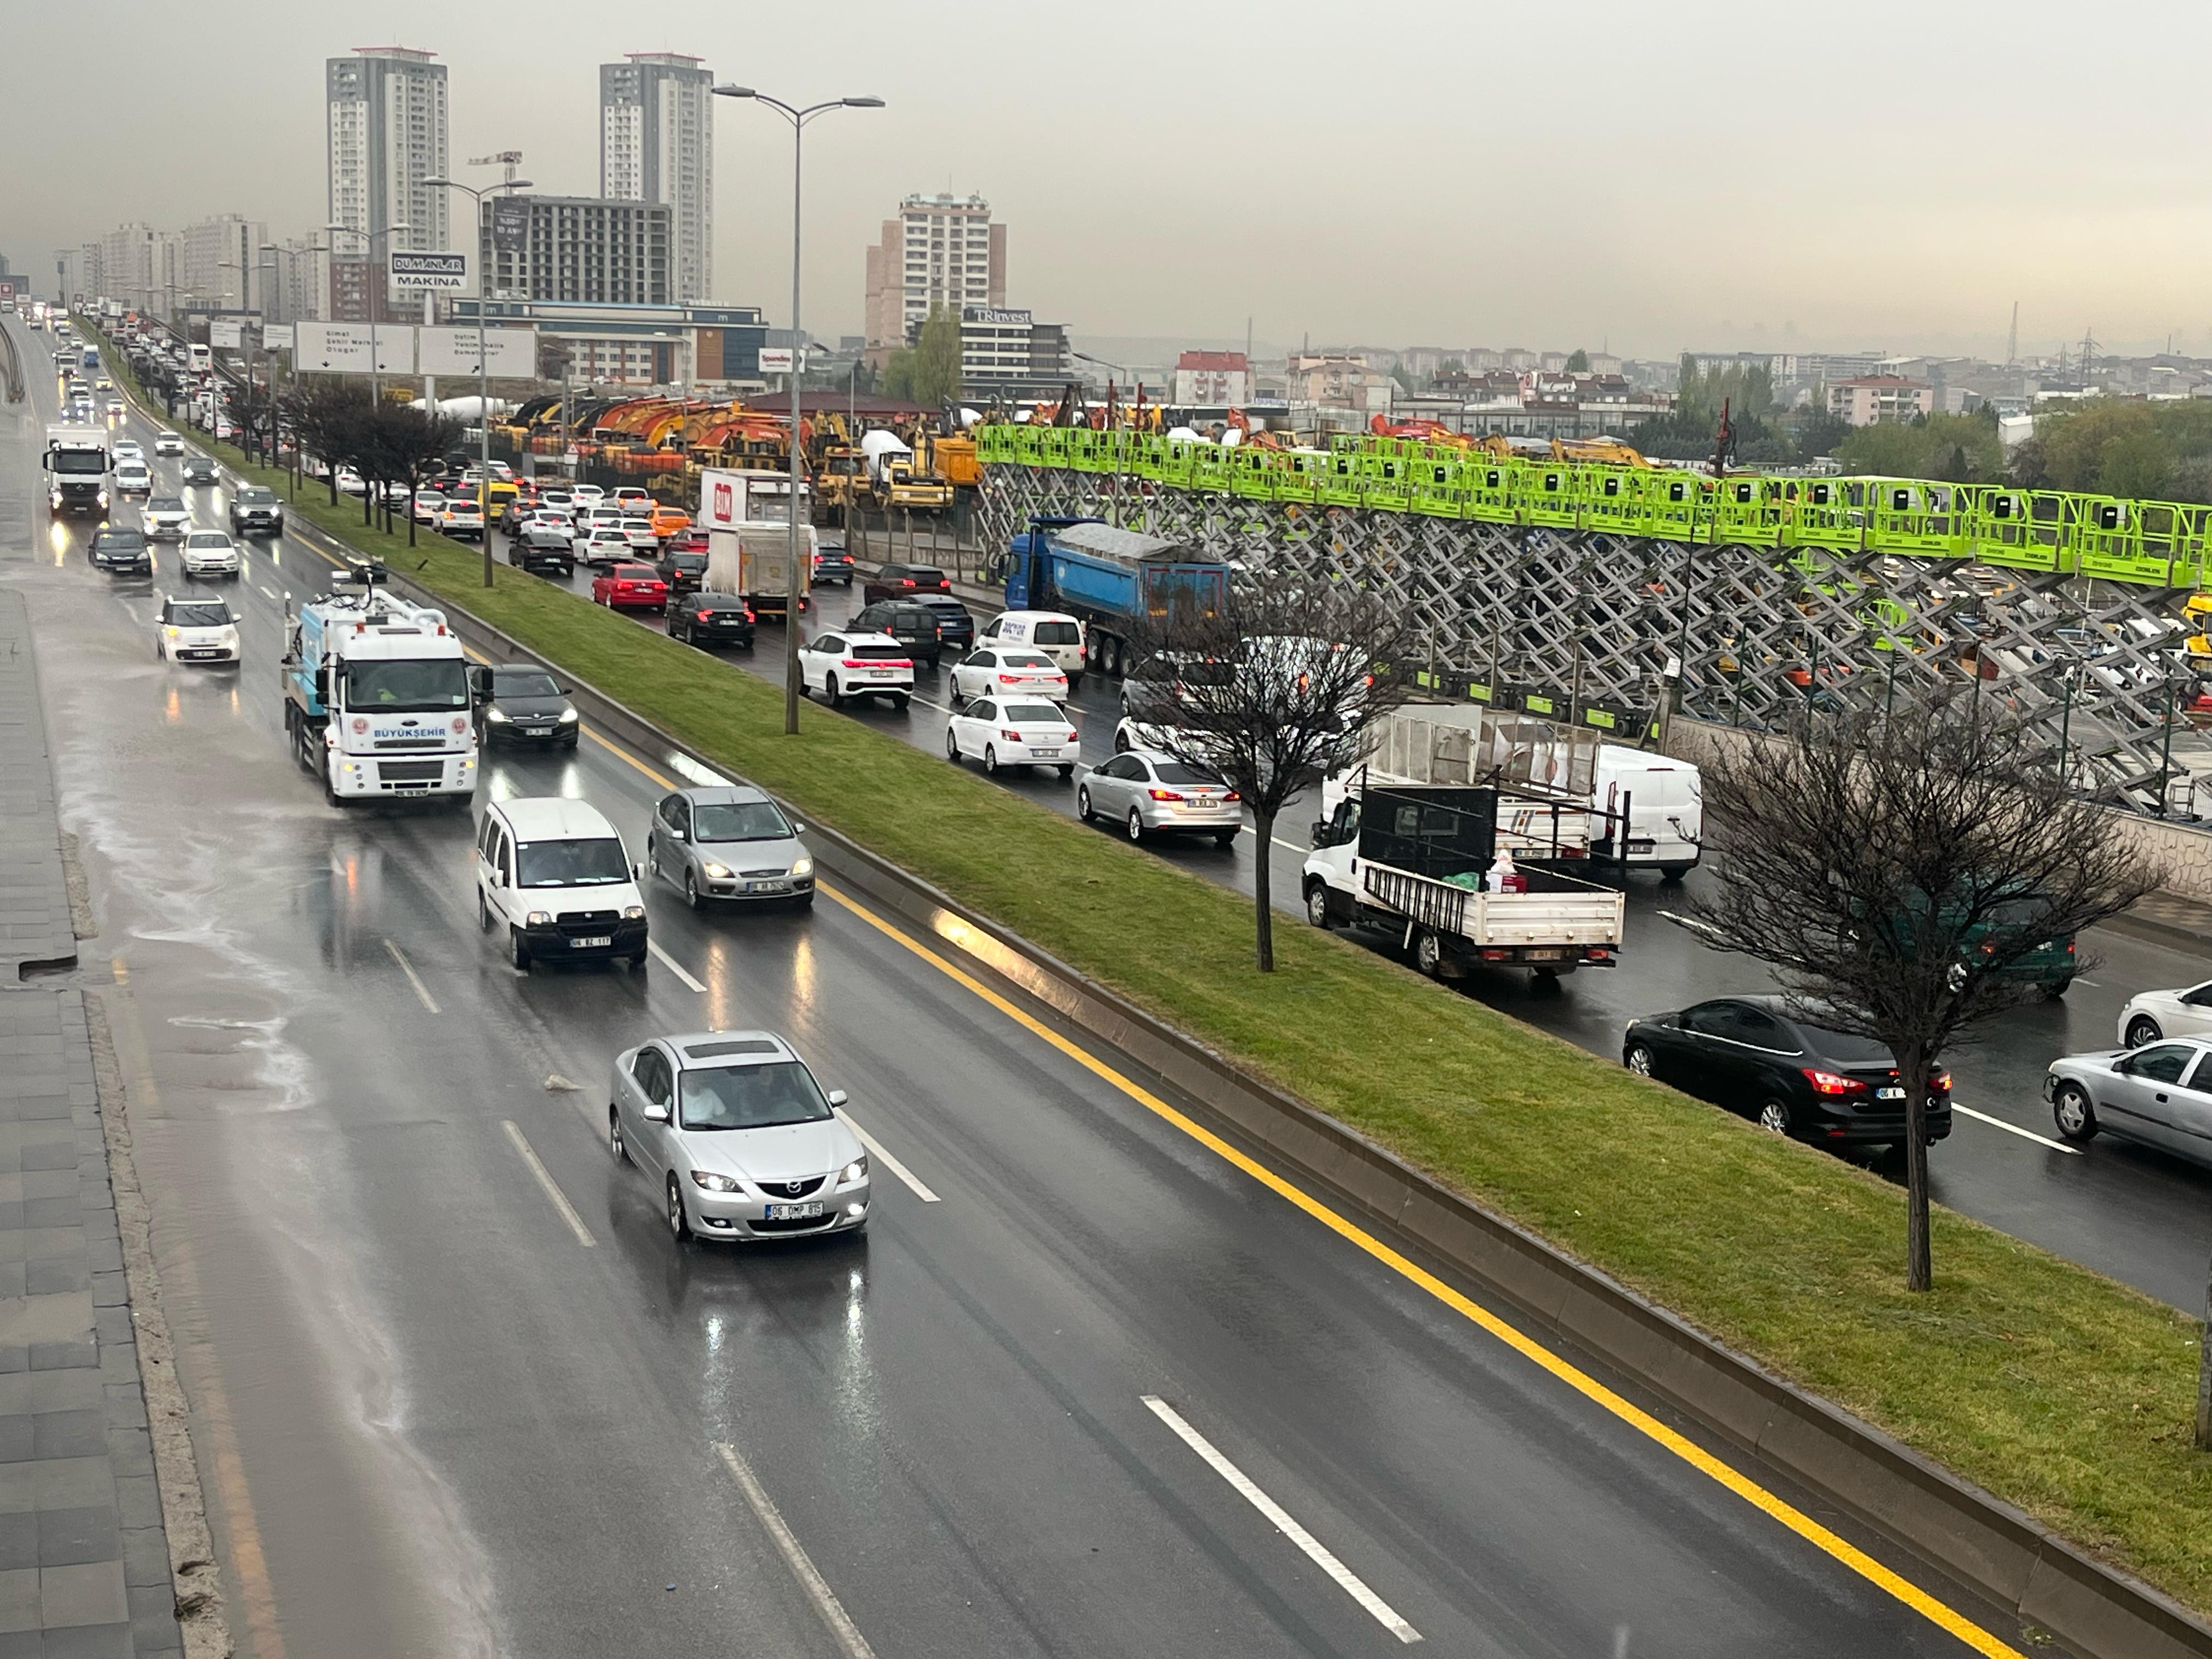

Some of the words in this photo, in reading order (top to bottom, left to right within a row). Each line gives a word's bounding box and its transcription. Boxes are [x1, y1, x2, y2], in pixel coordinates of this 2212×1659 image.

[393, 257, 464, 272] DUMANLAR
[398, 276, 461, 287] MAKİNA
[974, 309, 1029, 323] TRinvest
[374, 727, 446, 738] BÜYÜKŞEHİR
[772, 1207, 782, 1216] 06
